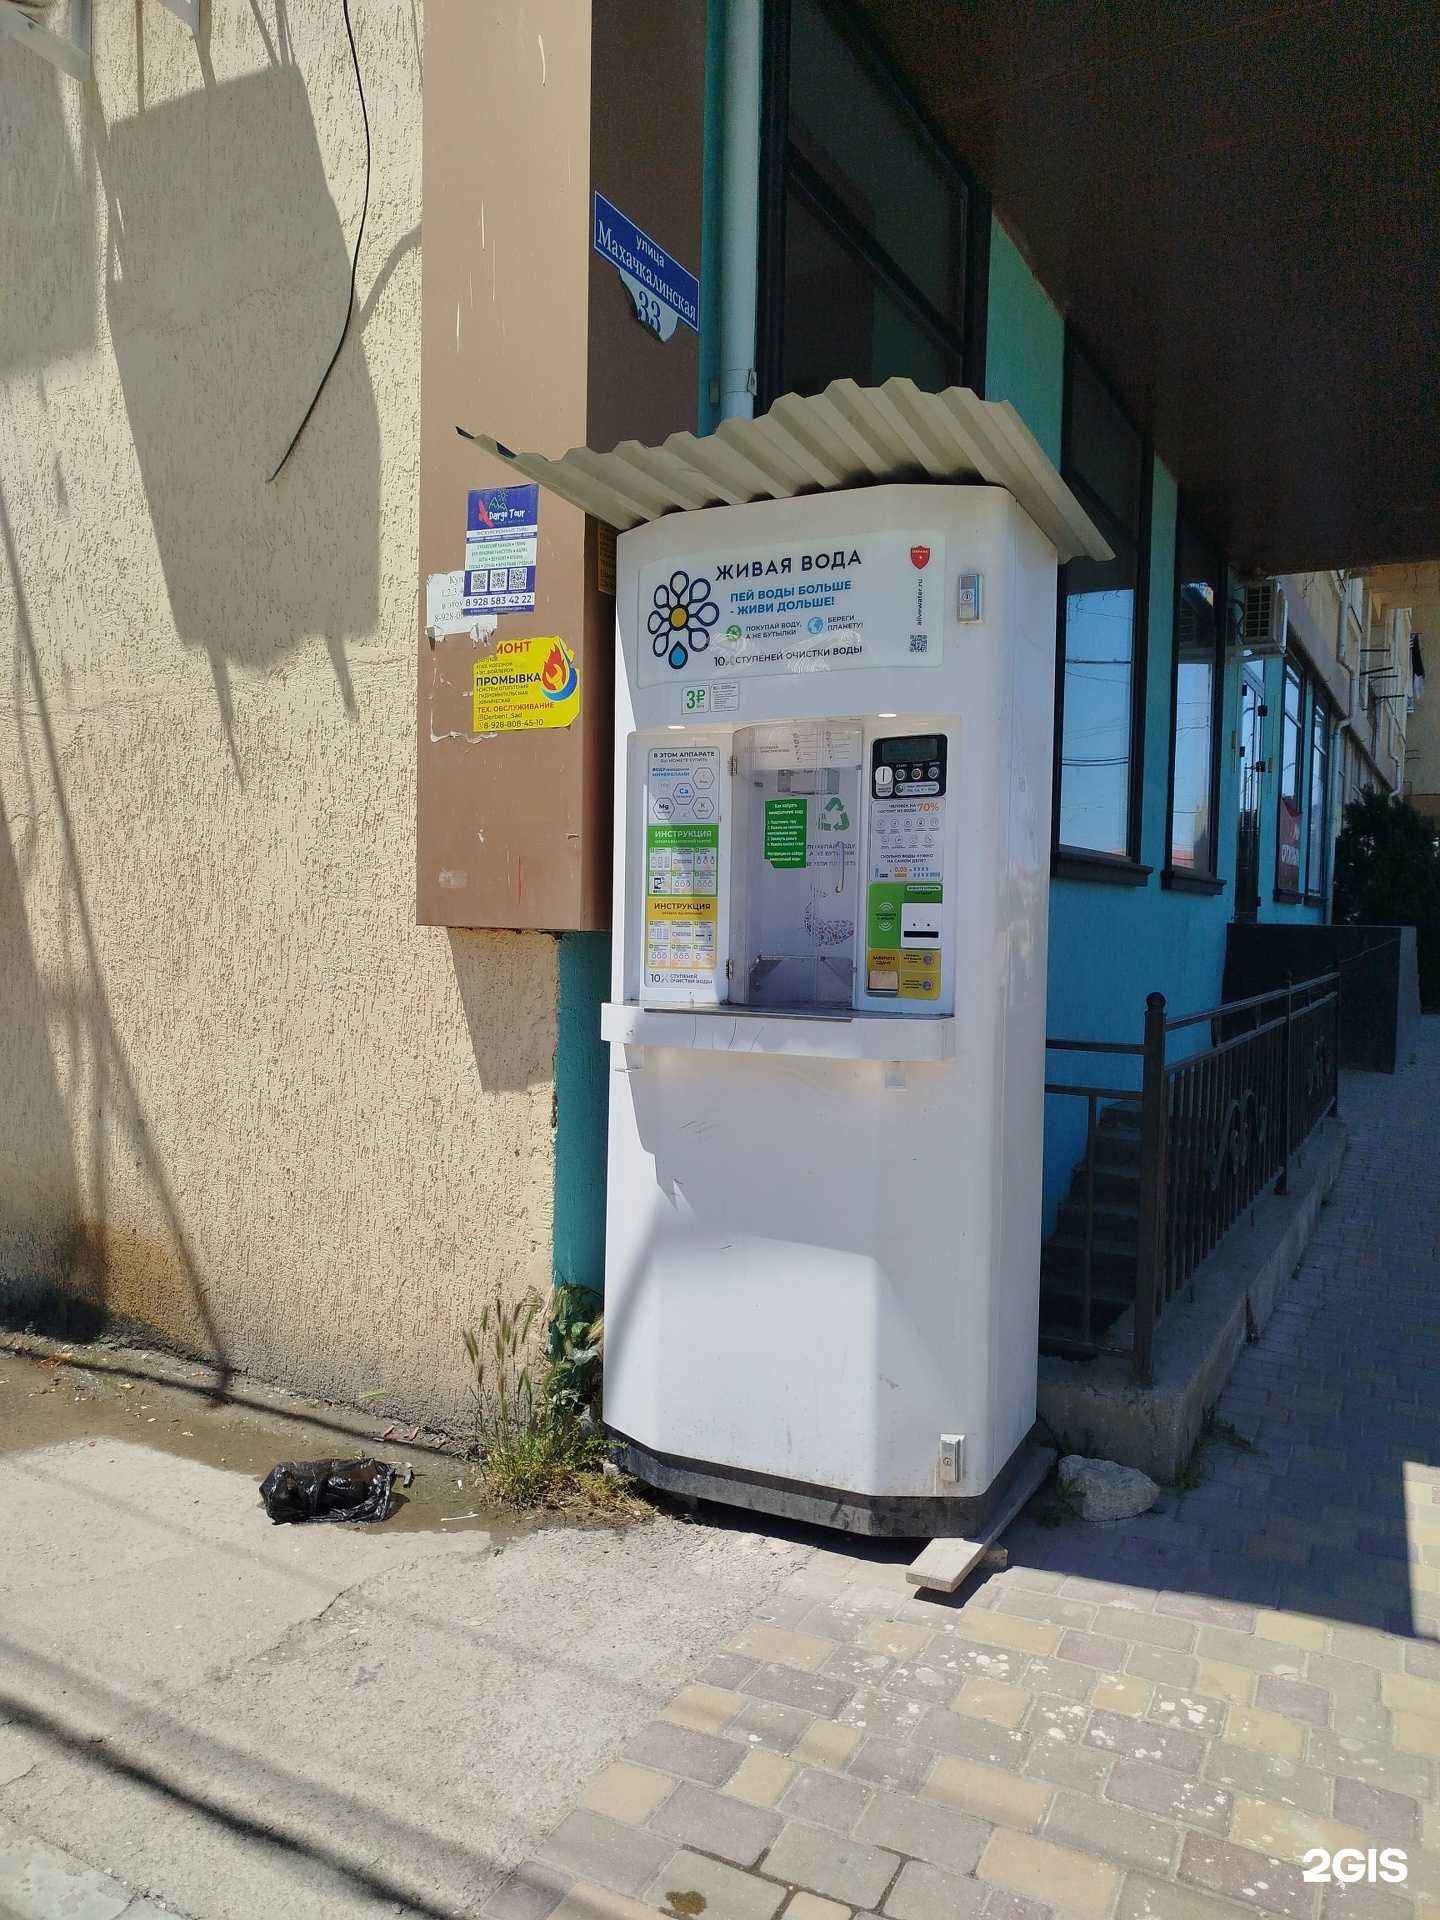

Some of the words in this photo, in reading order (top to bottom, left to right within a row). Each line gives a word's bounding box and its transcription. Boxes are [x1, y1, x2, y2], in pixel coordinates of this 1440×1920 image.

[636, 235, 665, 267] улица
[597, 219, 696, 321] Махачкалинская
[638, 291, 661, 333] 33
[509, 508, 525, 519] Tour
[715, 558, 792, 581] ЖИВАЯ
[801, 550, 862, 571] ВОДА
[730, 591, 754, 603] ПЕЙ
[758, 587, 795, 600] ВОДЫ
[798, 580, 852, 595] БОЛЬШЕ
[465, 598, 471, 607] 8
[473, 597, 488, 606] 928
[490, 596, 506, 605] 583
[508, 595, 520, 605] 42
[521, 594, 532, 604] 22
[737, 603, 774, 615] ЖИВИ
[777, 596, 835, 612] ДОЛЬШЕ!
[827, 615, 855, 623] БЕРЕГИ
[746, 623, 780, 632] ПОКУПАЙ
[827, 622, 863, 631] ПЛАНЕТУ!
[762, 629, 797, 638] БУТЫЛКИ
[735, 653, 783, 664] СТУПЕНЕЙ
[786, 649, 830, 659] ОЧИСТКИ
[833, 645, 863, 656] ВОДЫ
[476, 672, 542, 687] ПРОМЫВКА
[493, 702, 554, 712] ОБСЛУЖИВАНИЕ
[918, 802, 939, 812] 70%
[654, 830, 712, 838] ИНСТРУКЦИЯ
[654, 902, 711, 911] ИНСТРУКЦИЯ
[650, 973, 661, 983] 10
